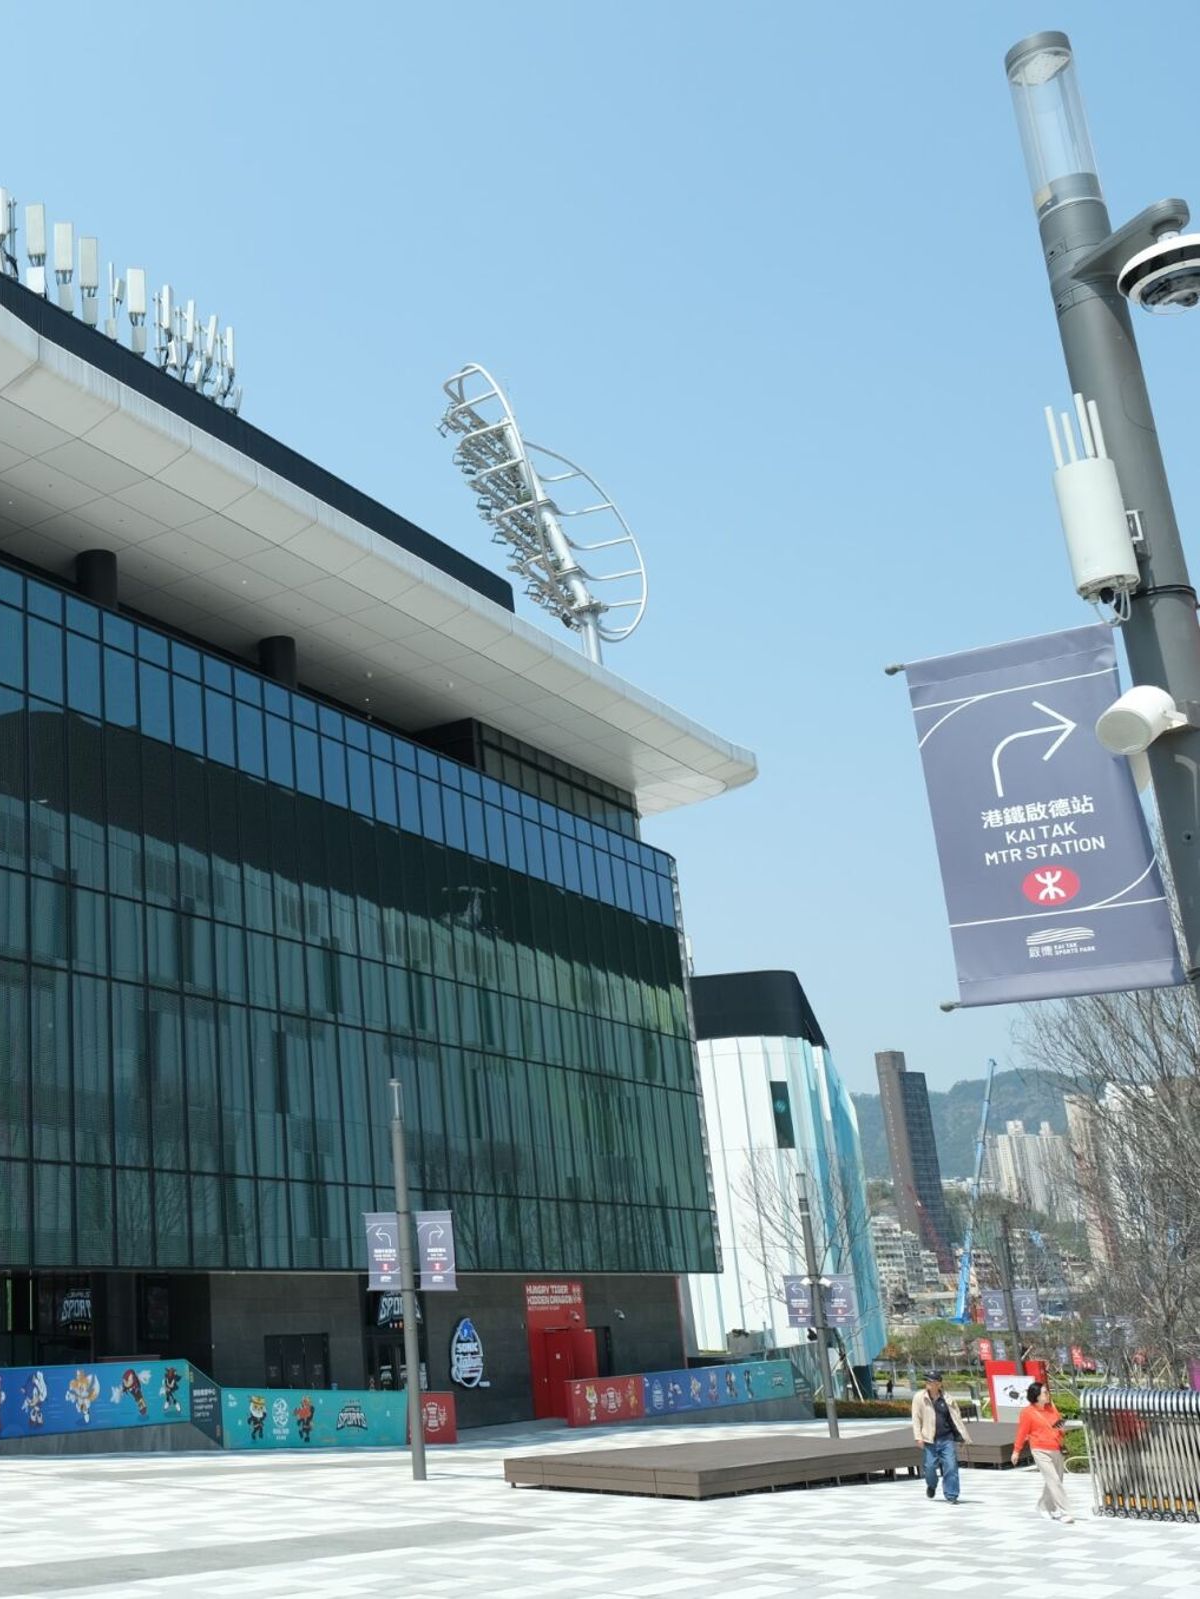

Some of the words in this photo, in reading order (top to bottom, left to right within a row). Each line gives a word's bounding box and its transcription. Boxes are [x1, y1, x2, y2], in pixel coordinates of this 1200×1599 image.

[981, 794, 1094, 829] 港鐵啟德站
[1005, 828, 1036, 845] KAI
[1039, 821, 1078, 839] TAK
[984, 848, 1022, 866] MTR
[1026, 836, 1106, 860] STATION
[1054, 947, 1079, 956] SPORTS
[526, 1285, 549, 1294] HUNGRY
[550, 1285, 568, 1294] TIGER
[337, 1412, 368, 1429] SPORTS
